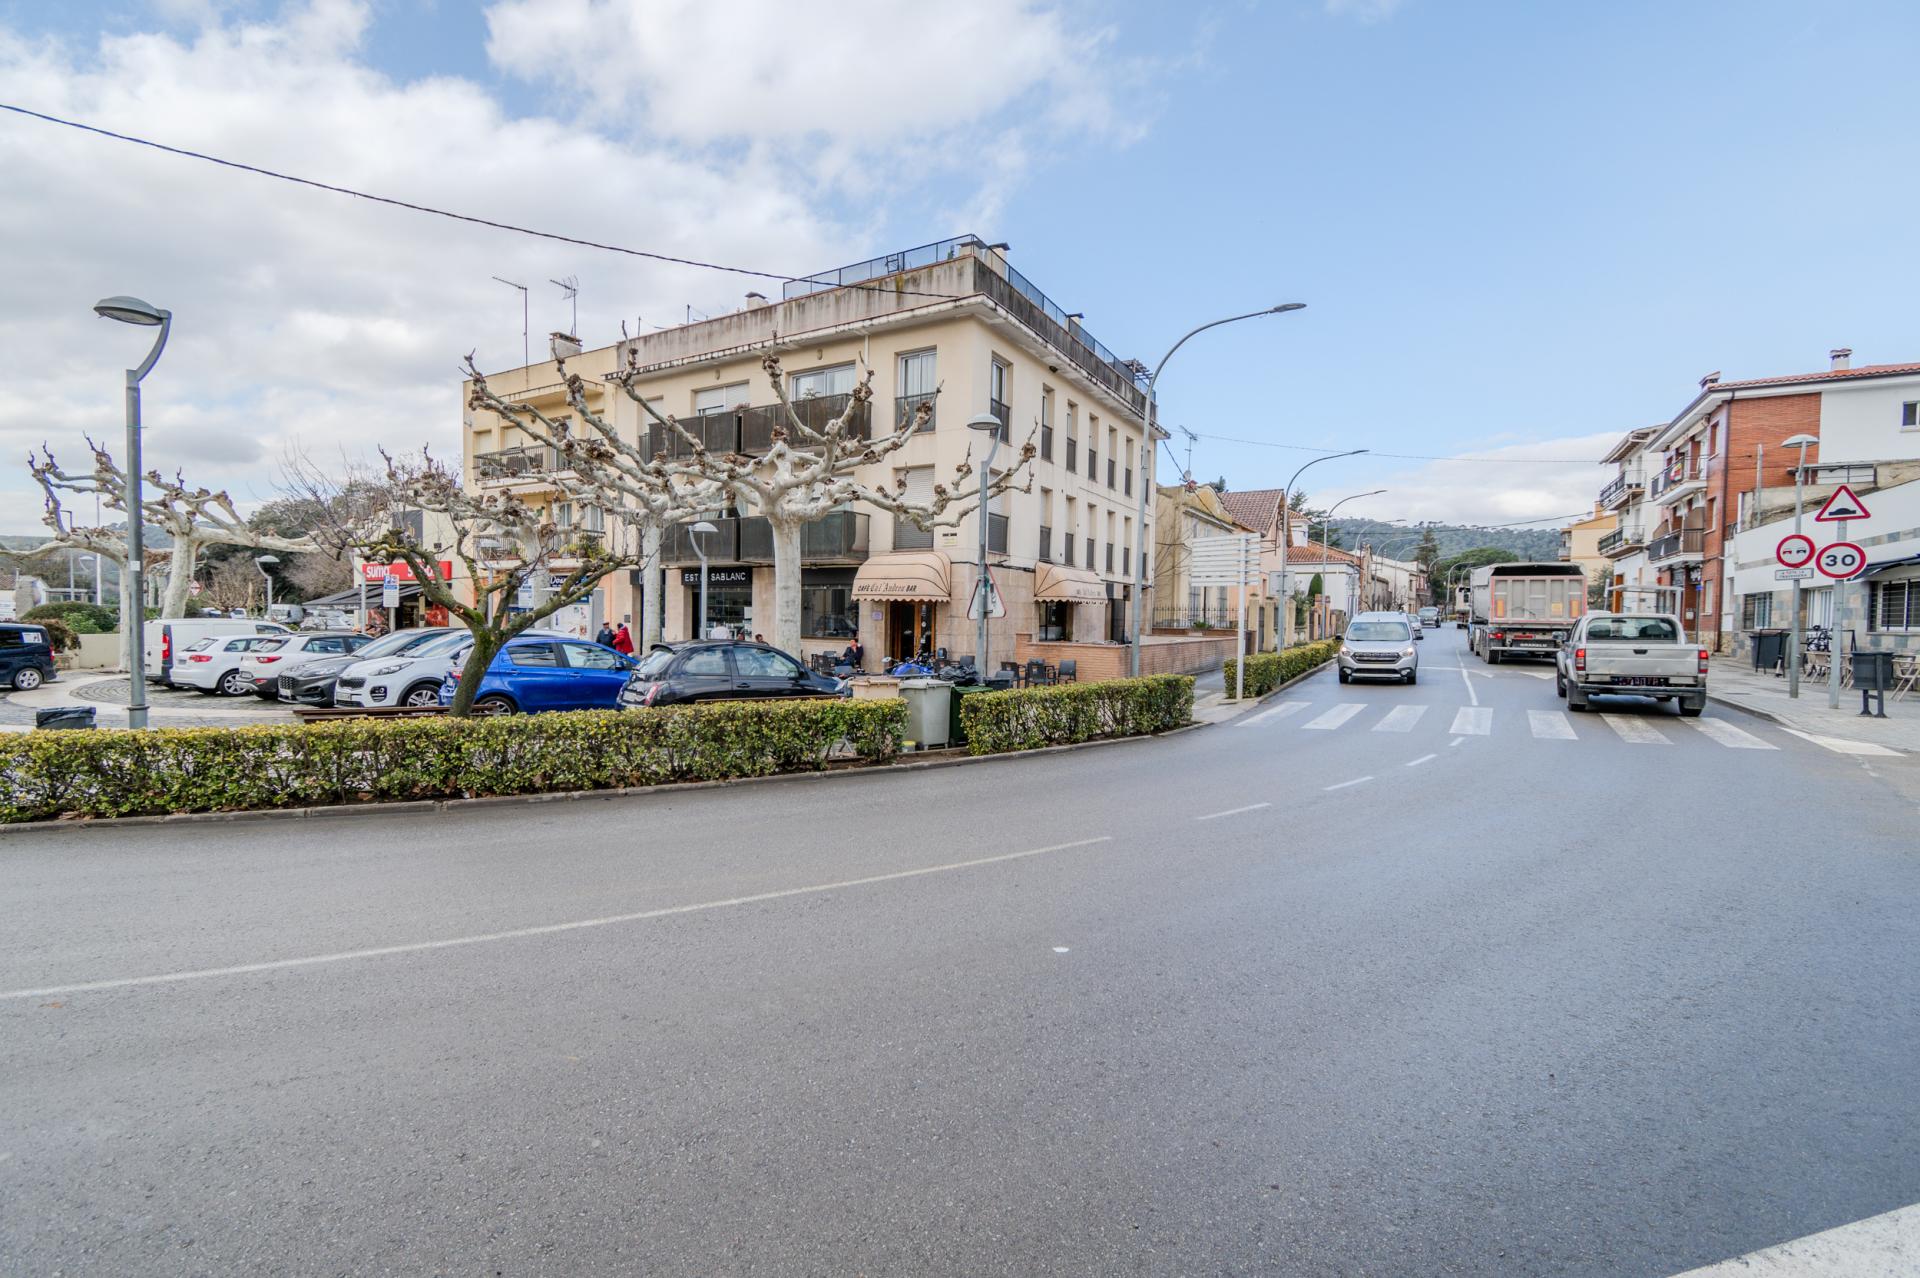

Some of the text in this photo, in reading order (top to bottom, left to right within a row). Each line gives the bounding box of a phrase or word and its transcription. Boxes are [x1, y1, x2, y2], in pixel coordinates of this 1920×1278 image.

[1825, 554, 1856, 567] 30
[684, 572, 746, 582] EST SABLANC
[906, 584, 918, 592] BAR
